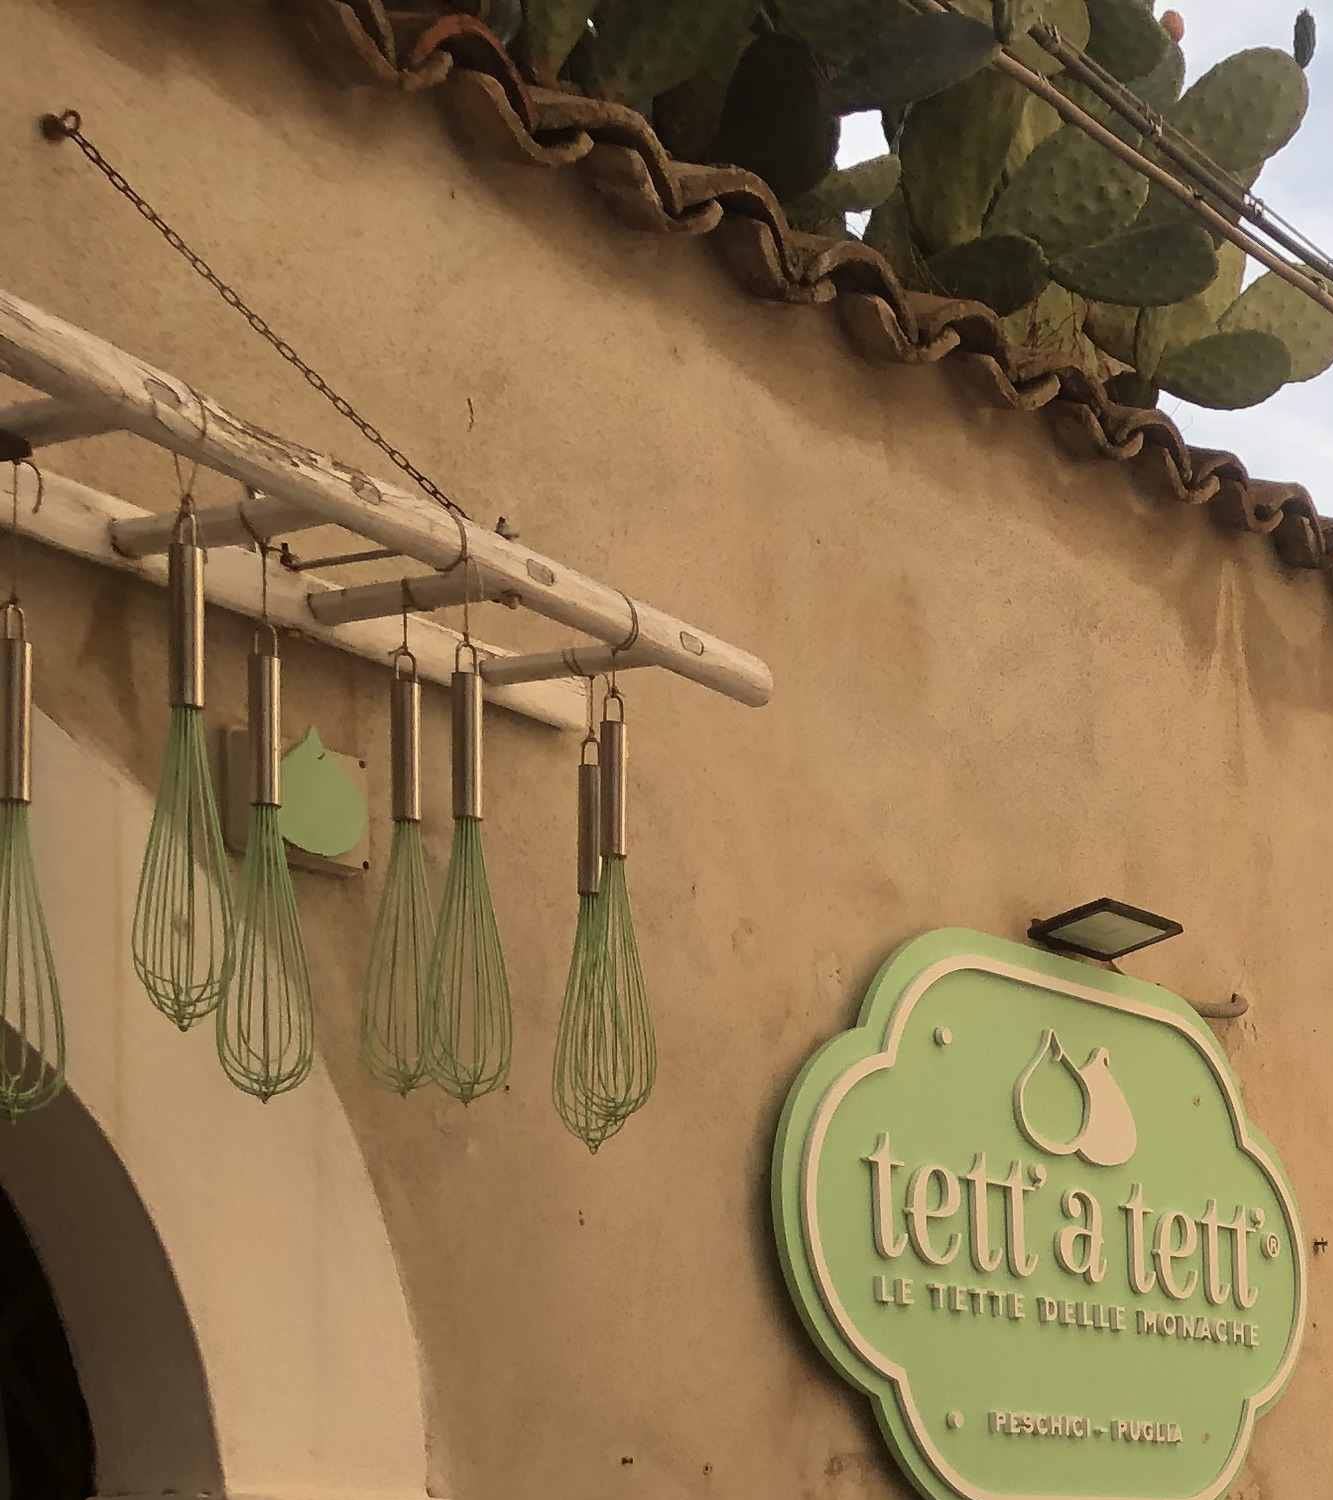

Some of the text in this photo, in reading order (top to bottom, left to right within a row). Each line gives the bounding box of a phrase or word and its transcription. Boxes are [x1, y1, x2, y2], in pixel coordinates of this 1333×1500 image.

[874, 1274, 1261, 1347] LE TETTE DELLE MONACHE
[988, 1411, 1091, 1438] PESCHICI
[1111, 1419, 1183, 1443] PUGLIA
